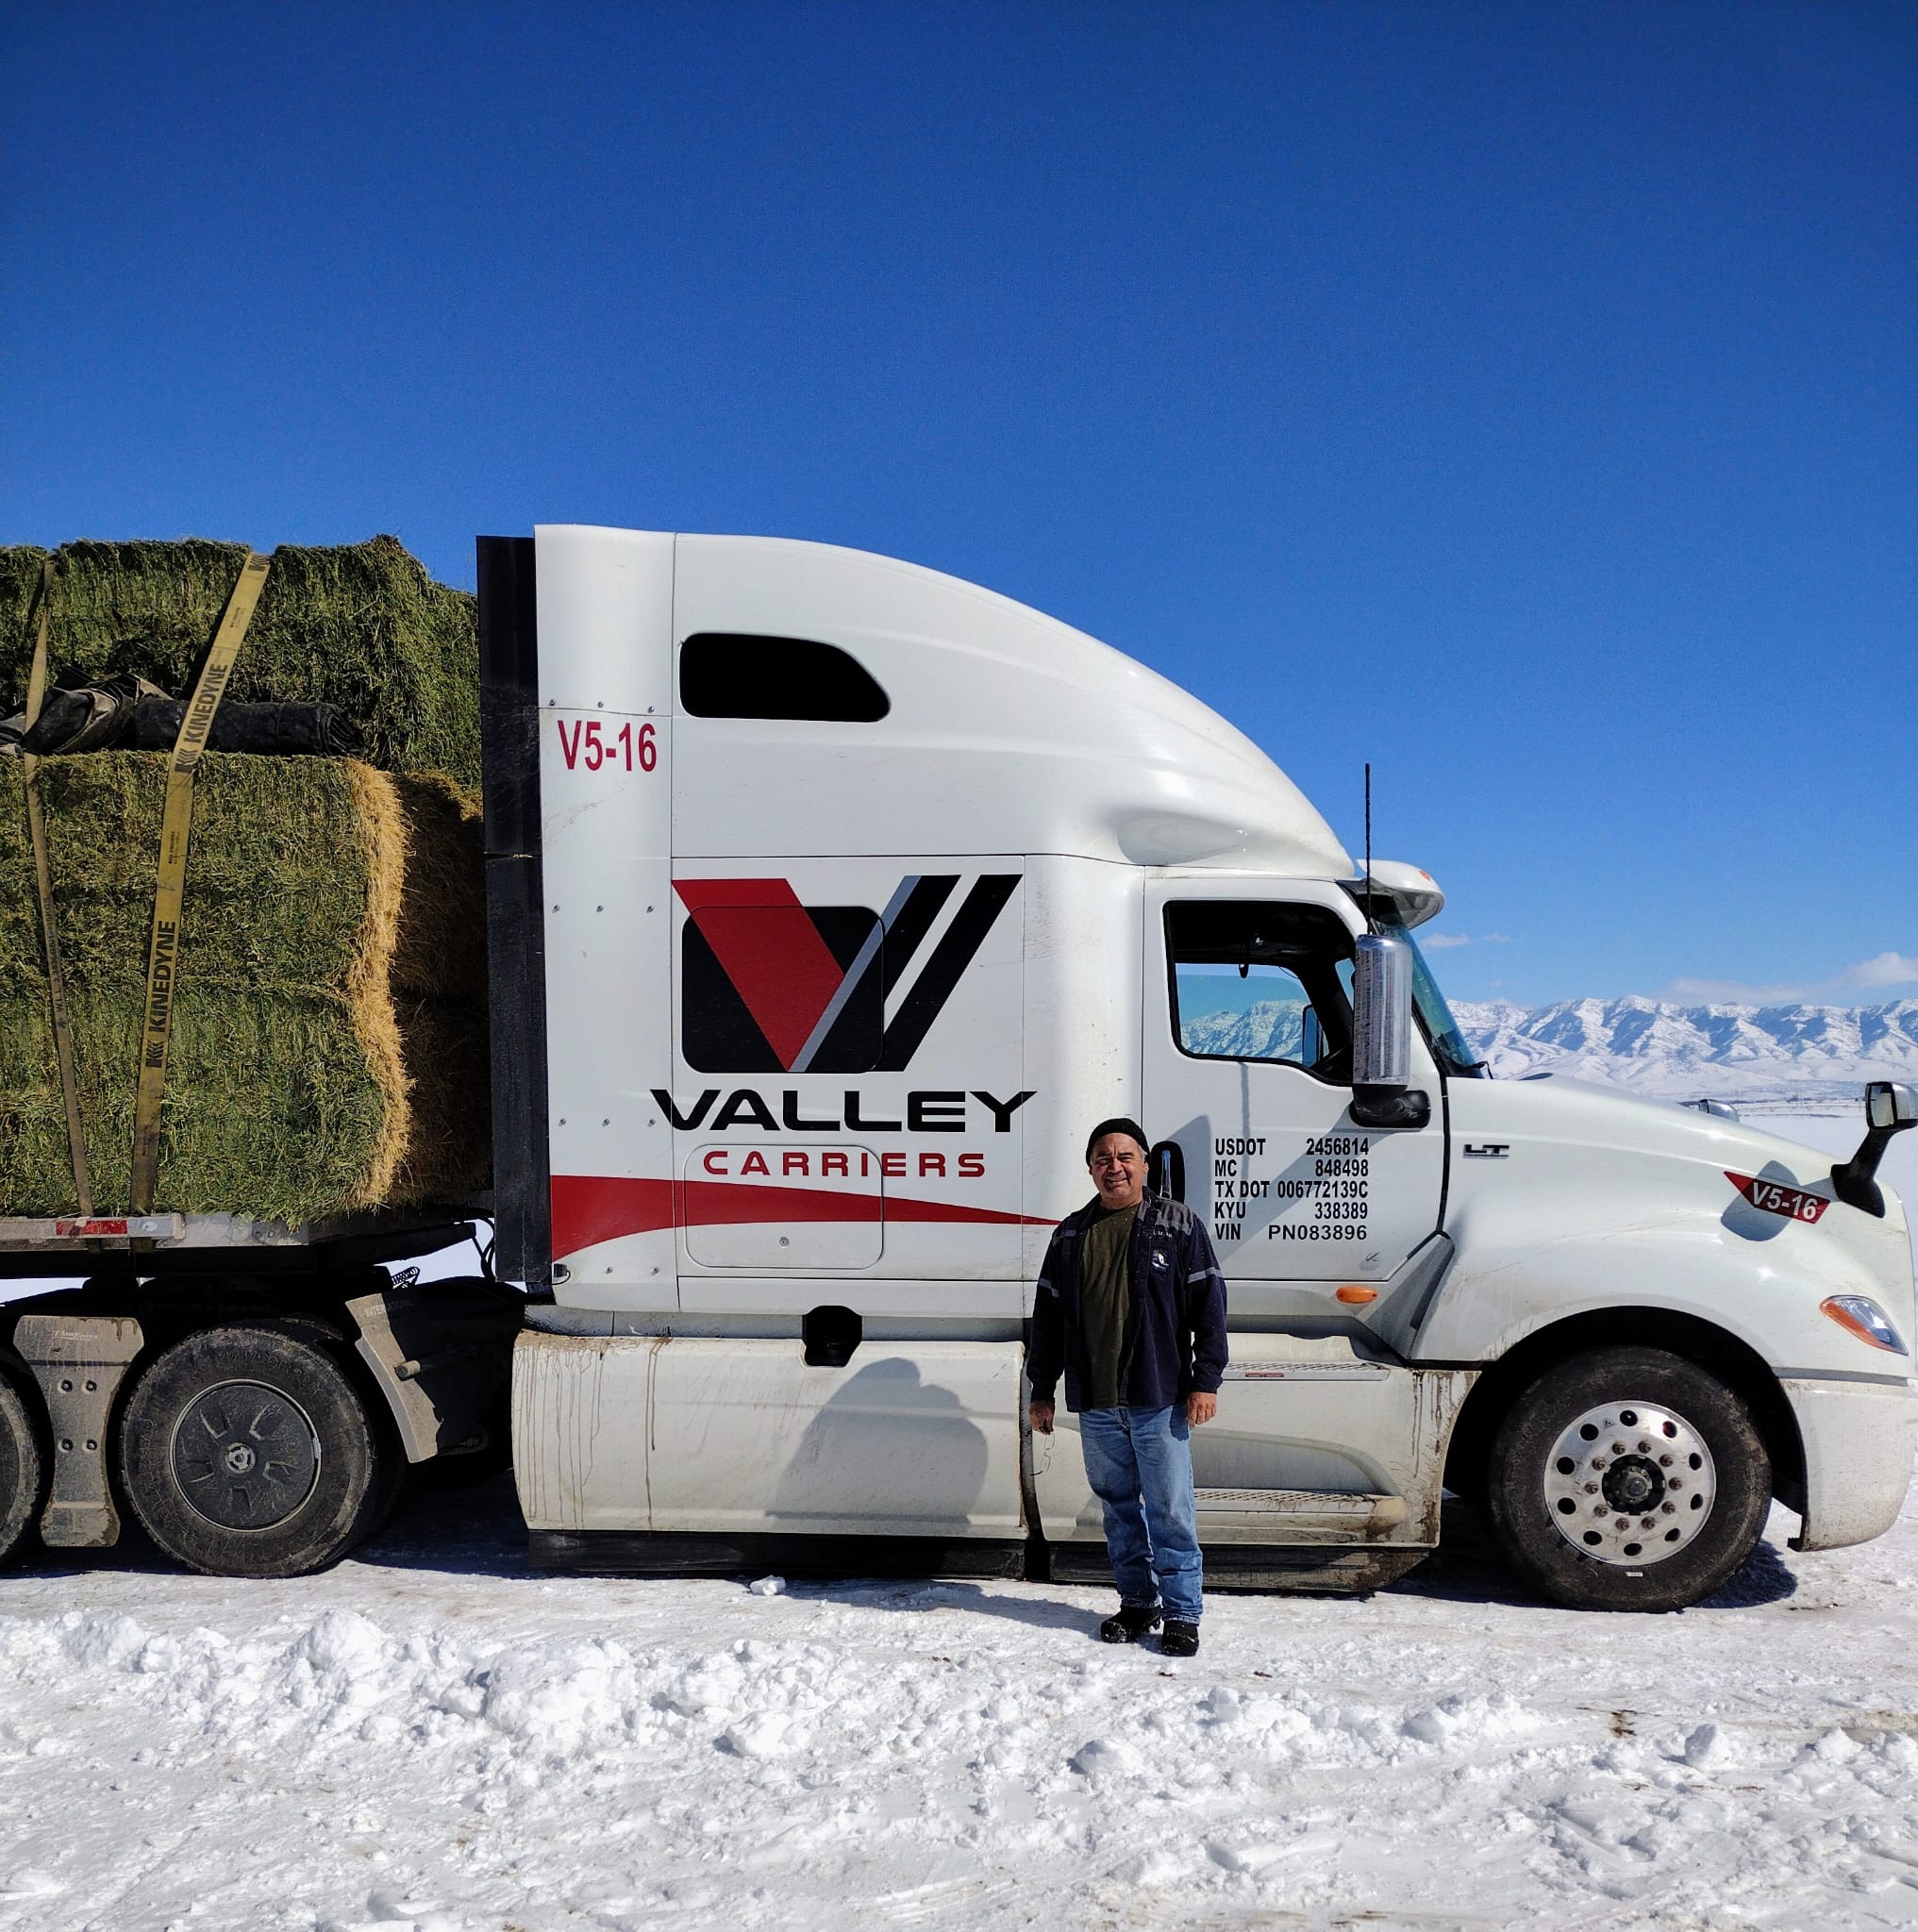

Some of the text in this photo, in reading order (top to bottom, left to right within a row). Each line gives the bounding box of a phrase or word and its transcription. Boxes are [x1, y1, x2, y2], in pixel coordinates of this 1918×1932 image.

[183, 663, 228, 743] KINEDYNE
[557, 720, 658, 772] V5-16
[148, 921, 176, 1033] KINEDYNE
[650, 1089, 1038, 1133] VALLEY
[1215, 1138, 1369, 1156] USDOT 2456814
[1464, 1143, 1509, 1157] LT
[704, 1151, 985, 1177] CARRIERS
[1214, 1159, 1369, 1177] MC 848498
[1214, 1181, 1368, 1199] TX DOT 006772139C
[1753, 1182, 1819, 1220] V5-16
[1214, 1202, 1368, 1220] KYU 338389
[1215, 1224, 1367, 1241] VIN PN083896
